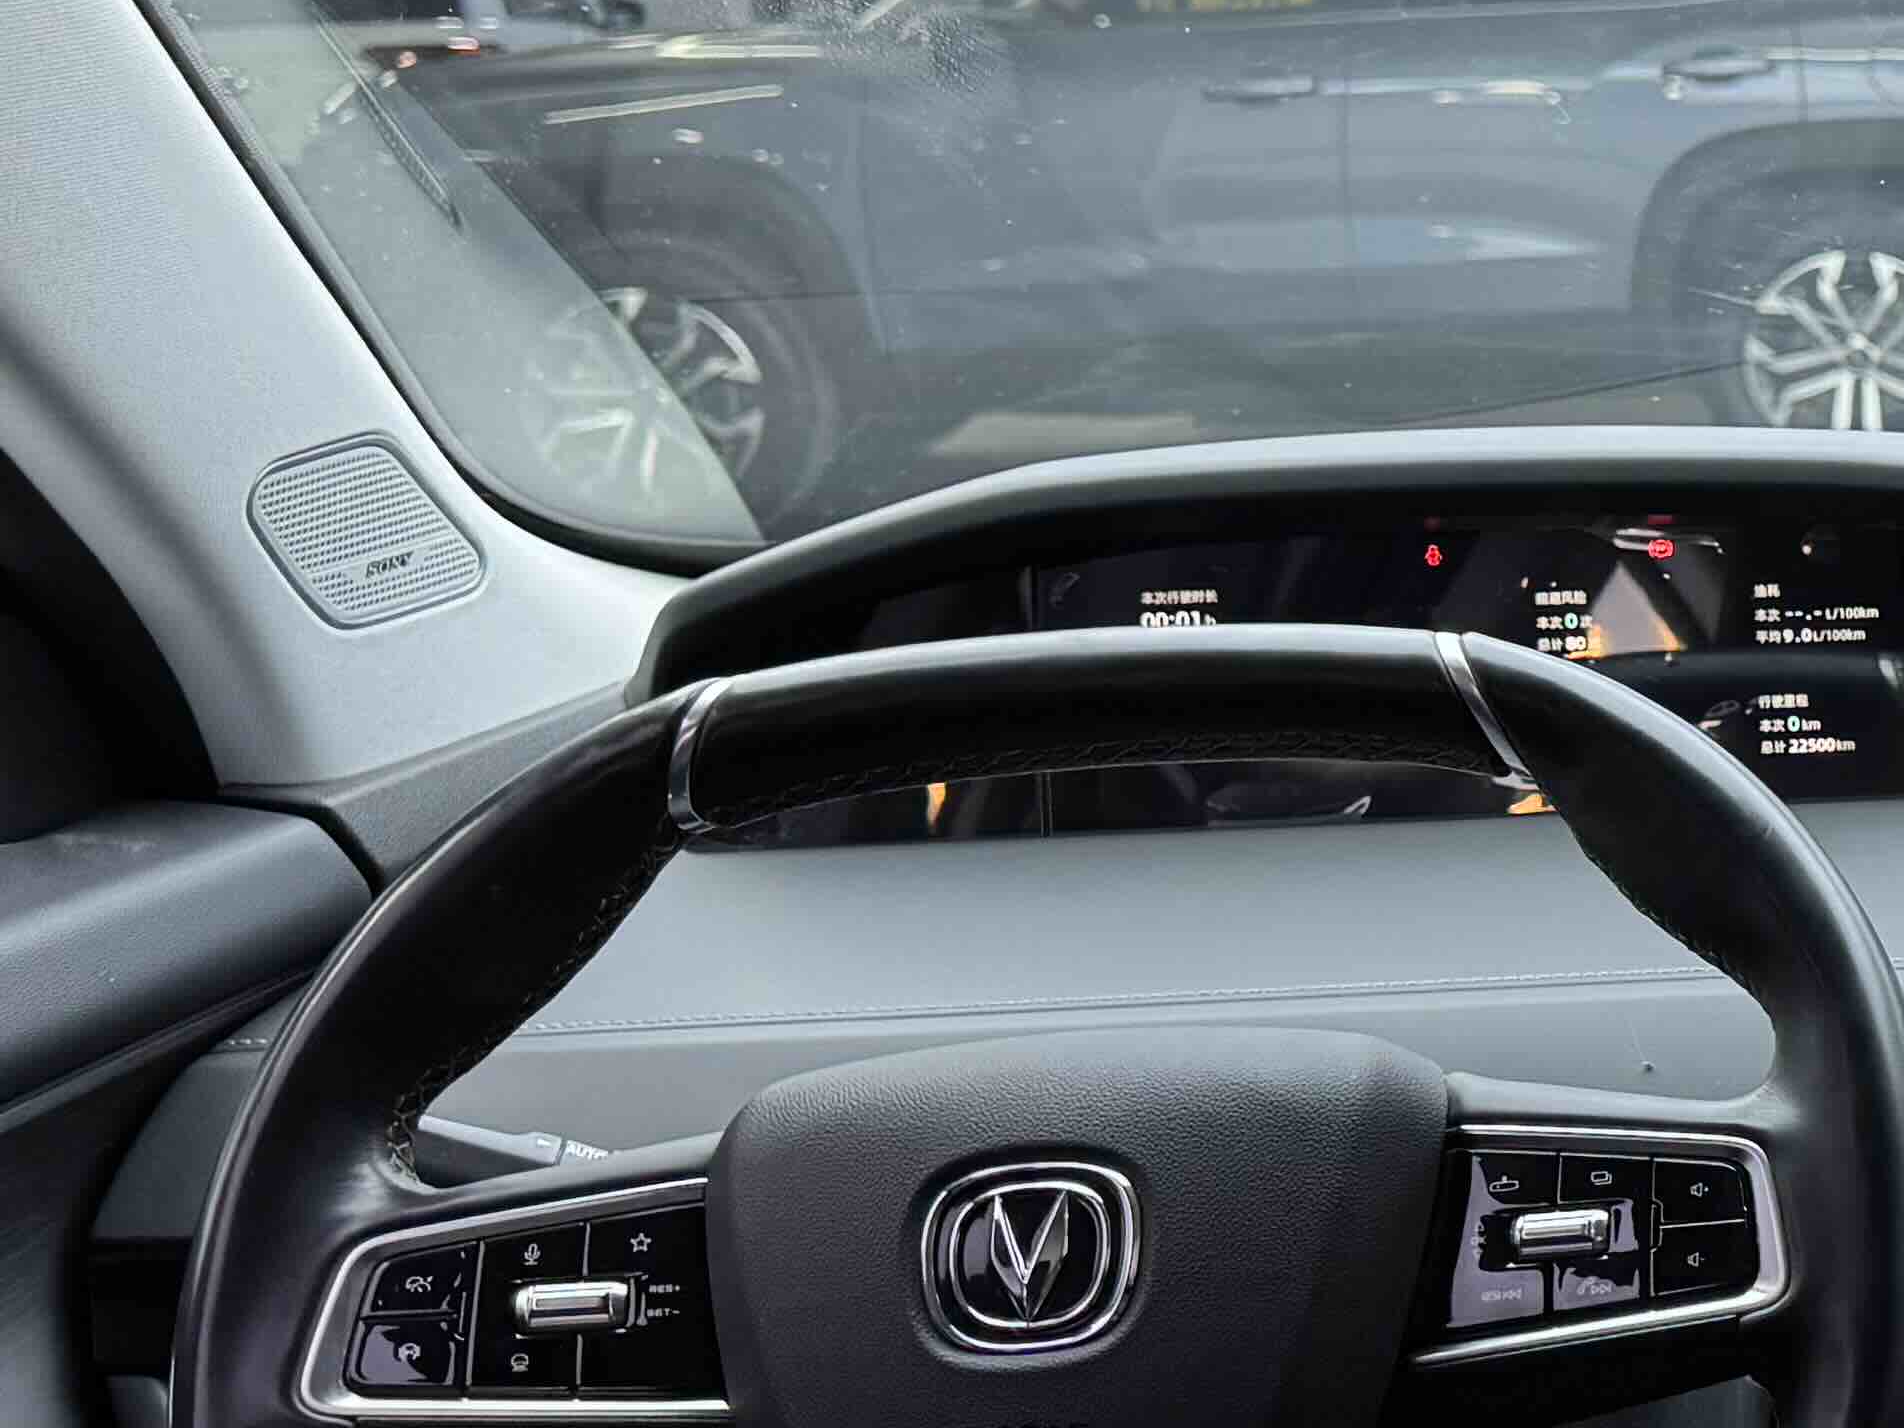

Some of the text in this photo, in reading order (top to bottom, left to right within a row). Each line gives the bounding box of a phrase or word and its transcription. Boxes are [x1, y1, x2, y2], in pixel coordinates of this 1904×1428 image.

[365, 551, 414, 579] SONY
[1753, 583, 1781, 598] 油耗
[1754, 608, 1781, 622] 本次
[1755, 629, 1782, 644] 平均
[1759, 715, 1822, 733] 本次 0 km
[1760, 740, 1787, 754] 总计
[1788, 737, 1836, 754] 22500
